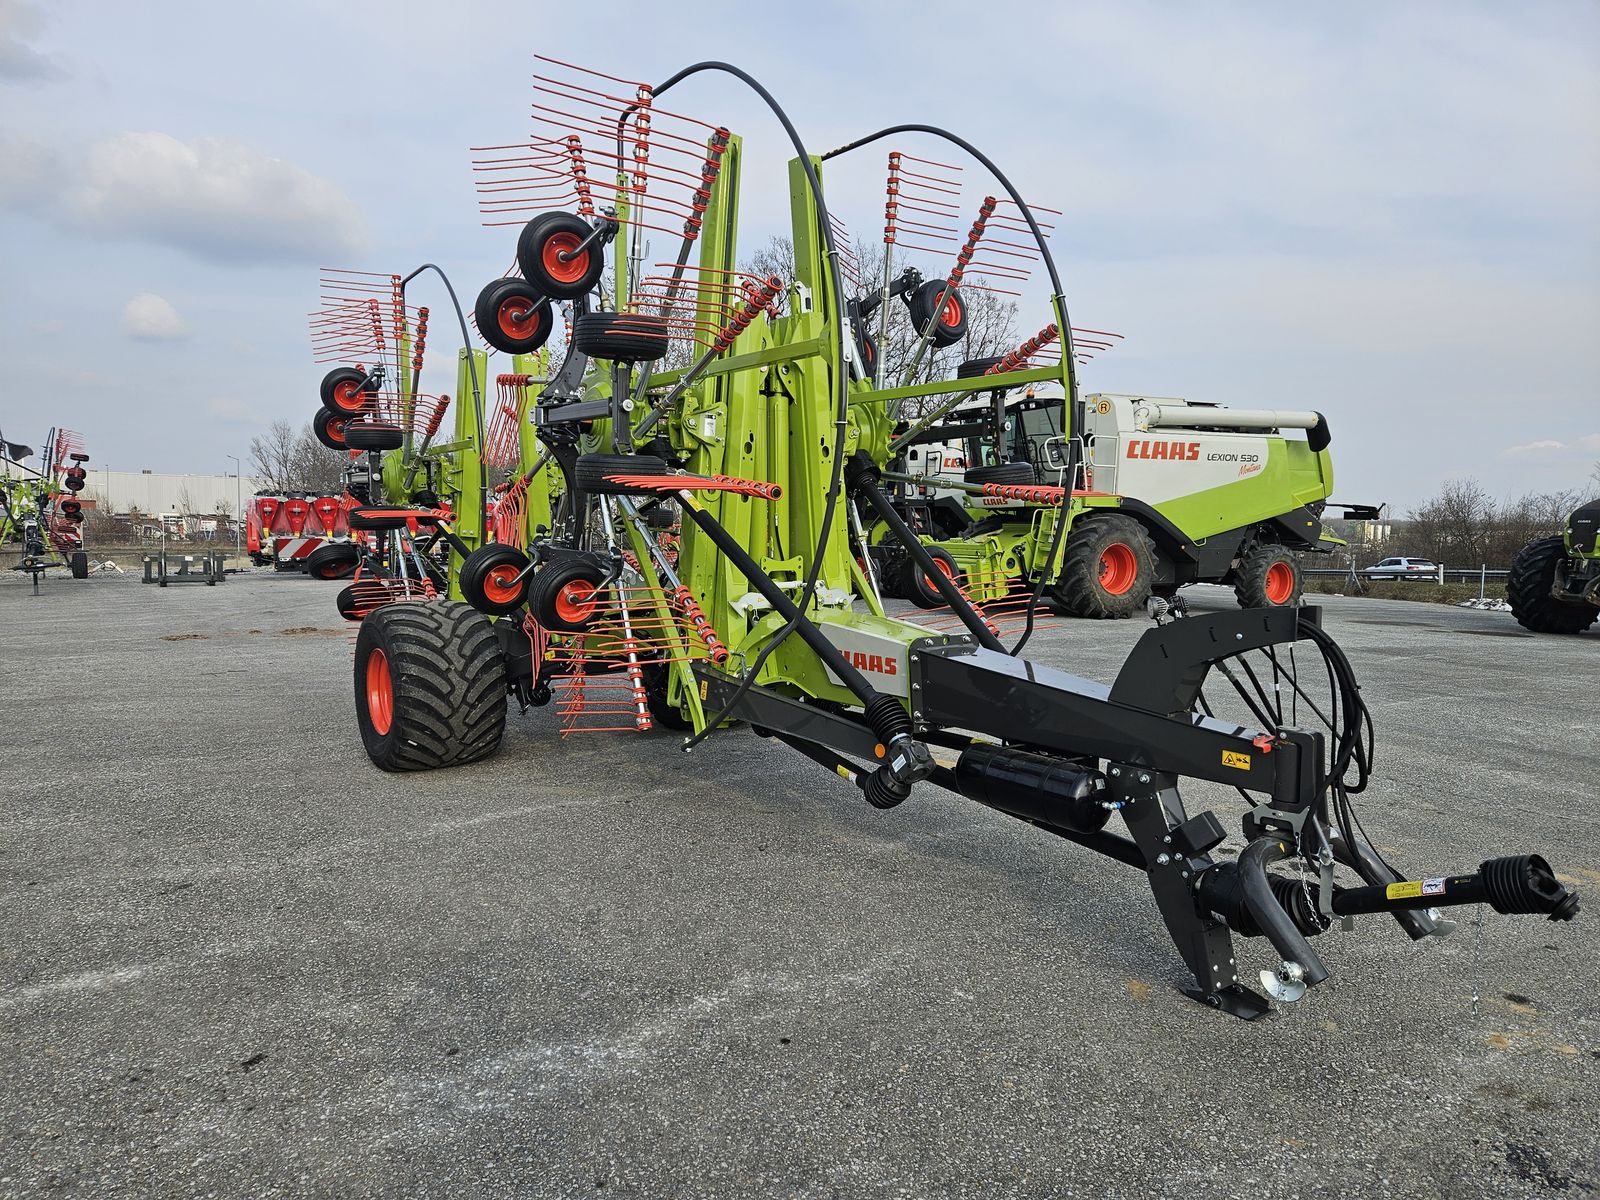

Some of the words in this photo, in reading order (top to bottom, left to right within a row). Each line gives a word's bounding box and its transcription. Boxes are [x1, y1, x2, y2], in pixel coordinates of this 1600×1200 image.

[1126, 440, 1201, 461] CLAAS
[1207, 453, 1239, 462] LEXION
[1240, 454, 1259, 463] 530
[983, 498, 1009, 506] CLAAS
